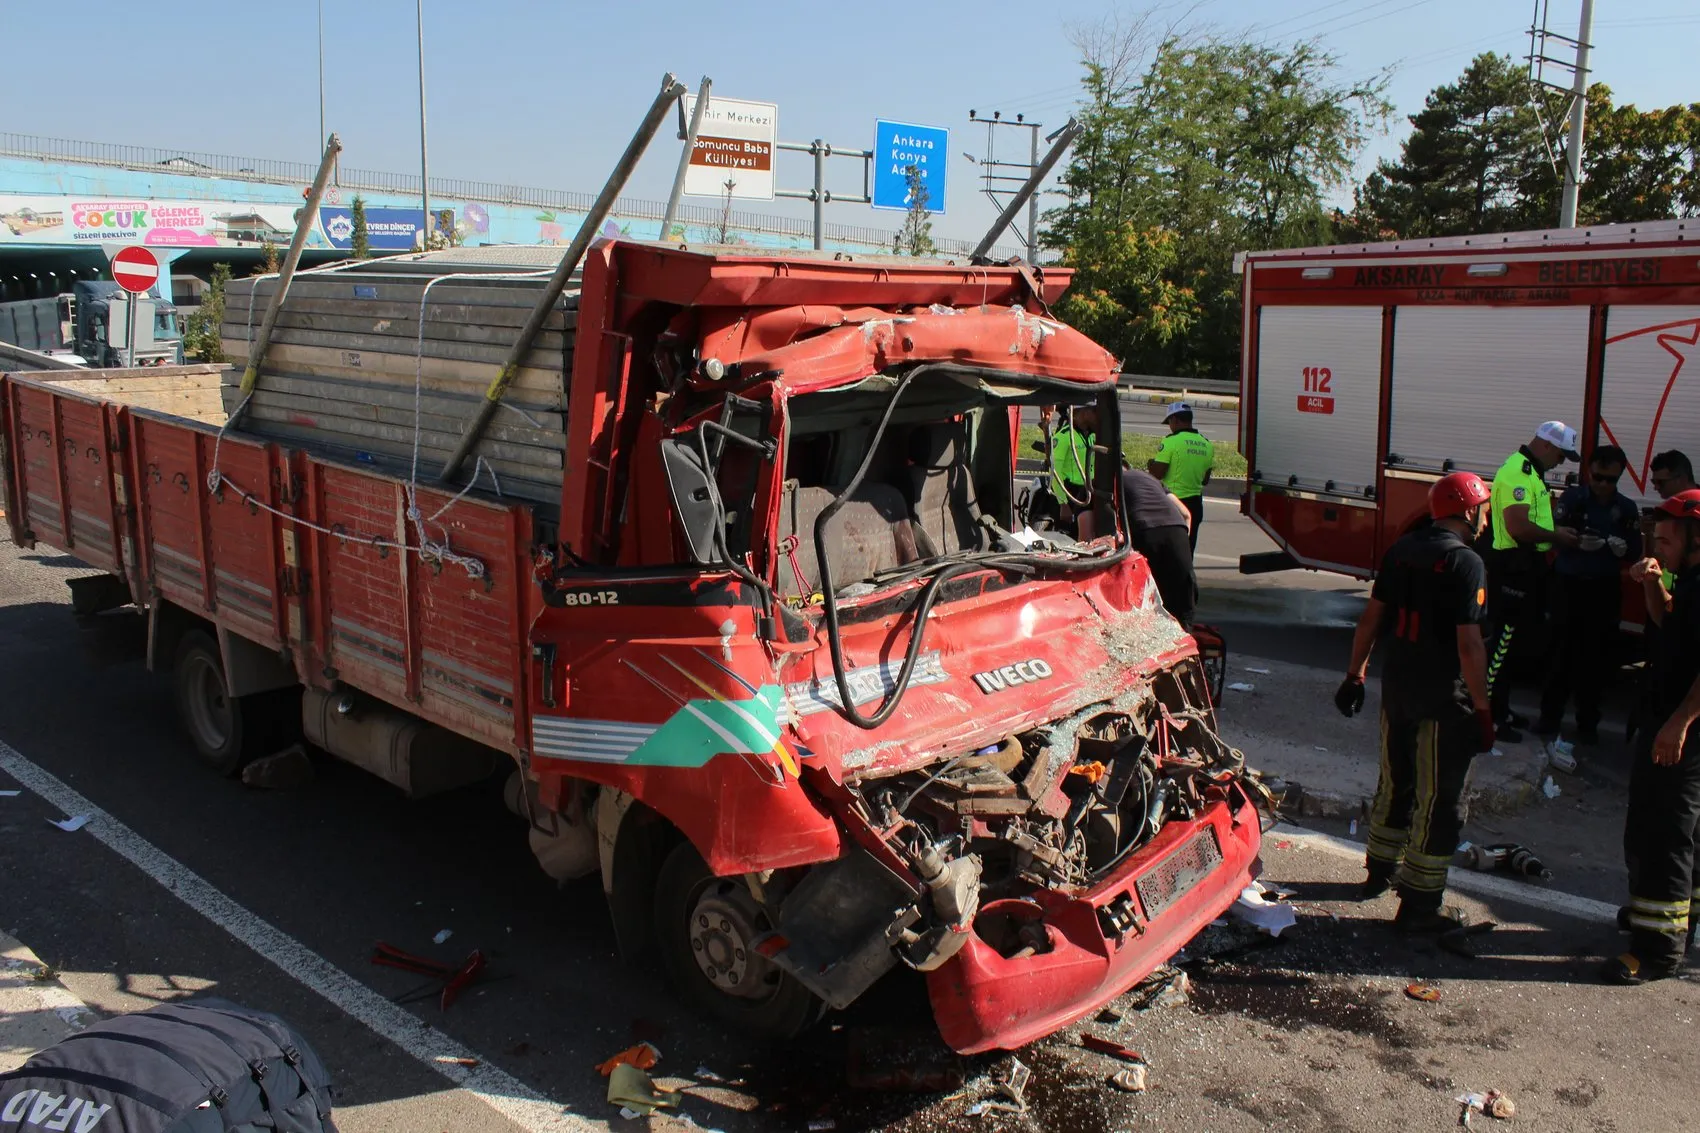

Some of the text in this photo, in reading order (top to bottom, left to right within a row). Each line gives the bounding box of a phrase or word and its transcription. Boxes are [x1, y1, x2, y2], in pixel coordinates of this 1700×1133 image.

[727, 111, 771, 125] Merkezi
[693, 139, 769, 154] Somuncu Baba
[892, 133, 934, 149] Ankara
[705, 152, 757, 167] Külliyesi
[891, 148, 927, 165] Konya
[891, 163, 928, 178] Ada
[73, 210, 148, 229] ÇOCUK
[151, 206, 200, 218] EĞLENCE
[155, 215, 205, 228] MERKEZİ
[1354, 264, 1445, 286] AKSARAY
[1302, 367, 1332, 393] 112
[565, 591, 619, 606] 80-12
[972, 658, 1053, 695] IVECO
[1, 1088, 112, 1133] AFAD
